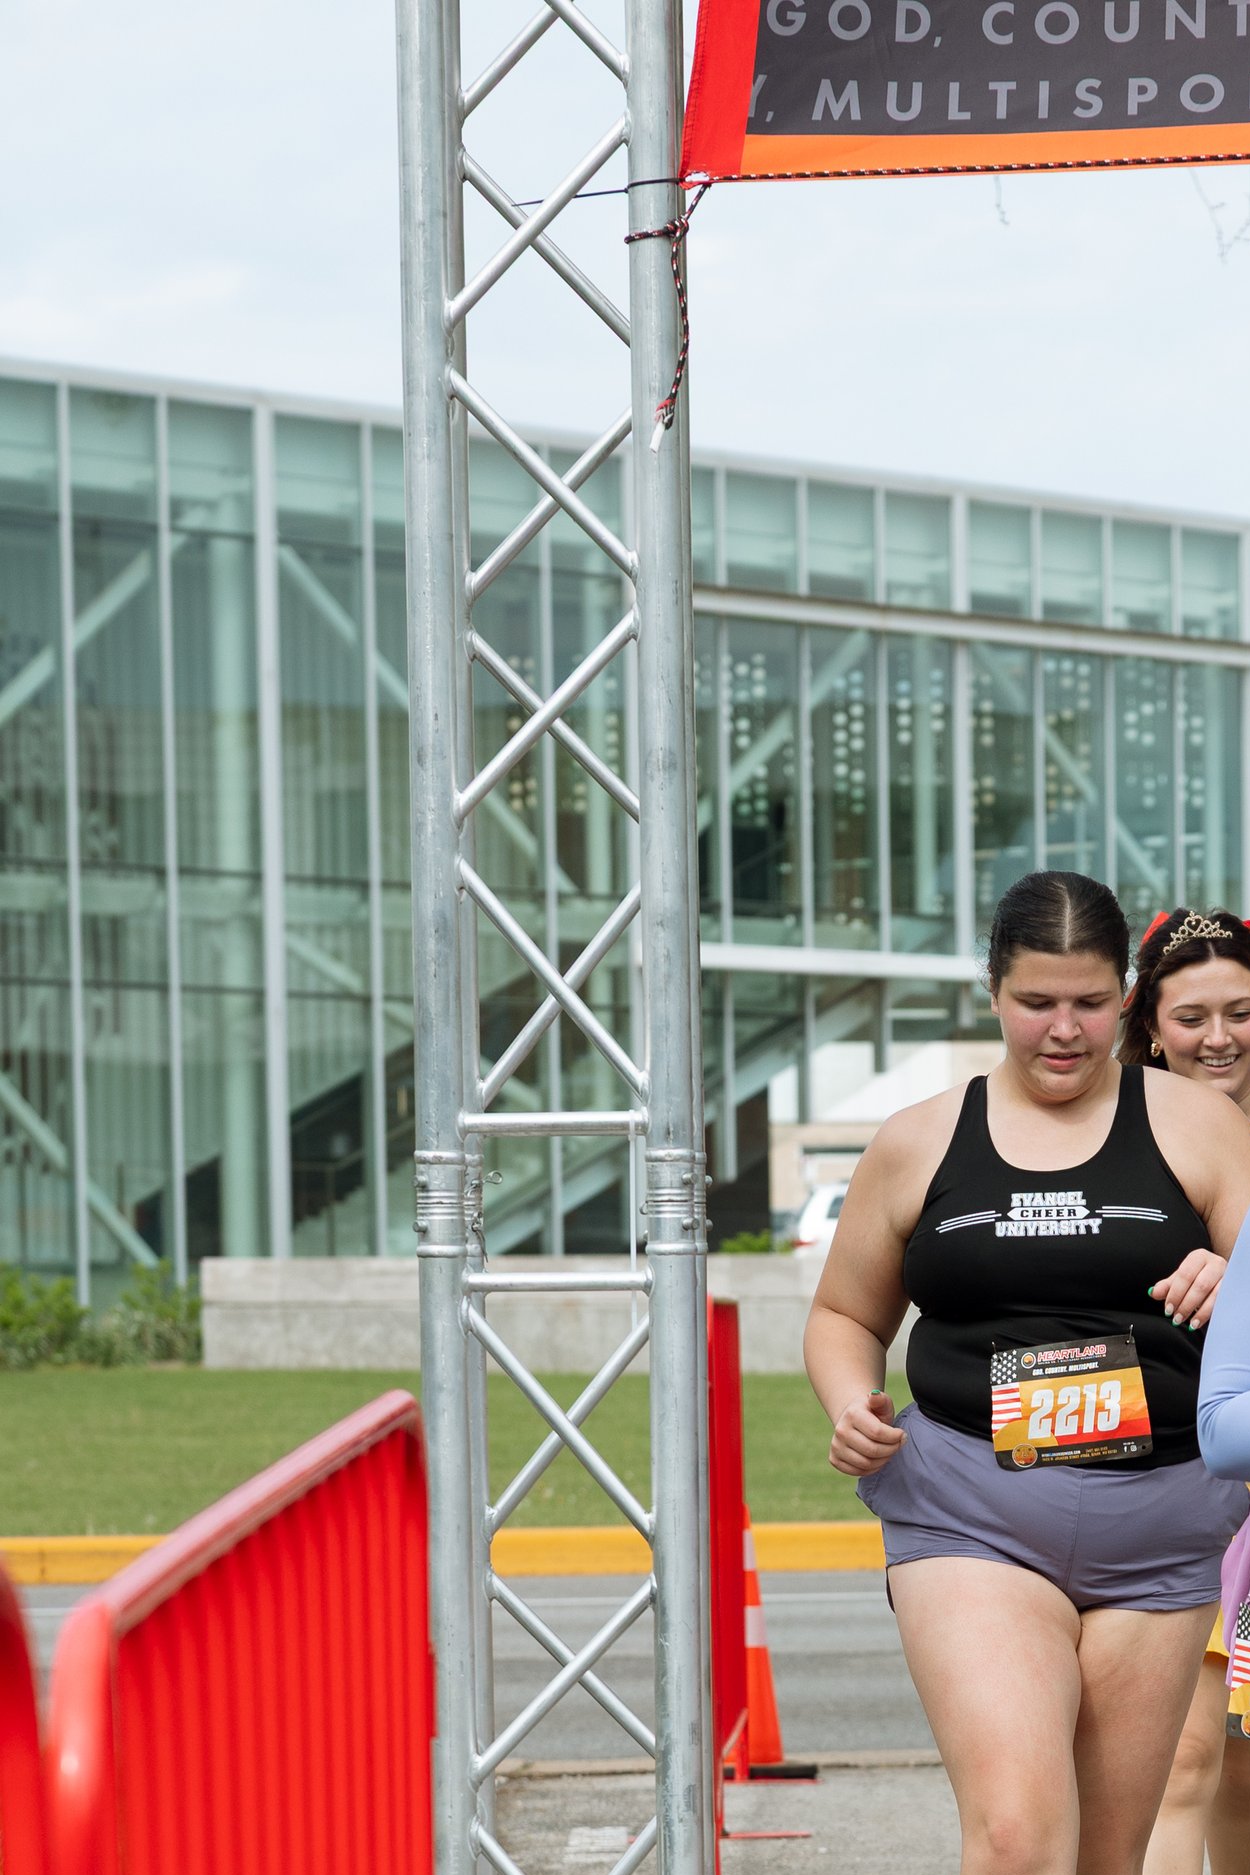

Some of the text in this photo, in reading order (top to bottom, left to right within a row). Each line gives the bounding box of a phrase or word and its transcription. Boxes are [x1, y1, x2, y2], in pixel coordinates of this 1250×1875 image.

[766, 0, 942, 48] GOD,
[1011, 1191, 1087, 1207] EVANGEL
[1020, 1208, 1077, 1218] CHEER
[995, 1218, 1102, 1237] UNIVERSITY
[1037, 1344, 1107, 1363] HEARTLAND
[1028, 1380, 1121, 1440] 2213
